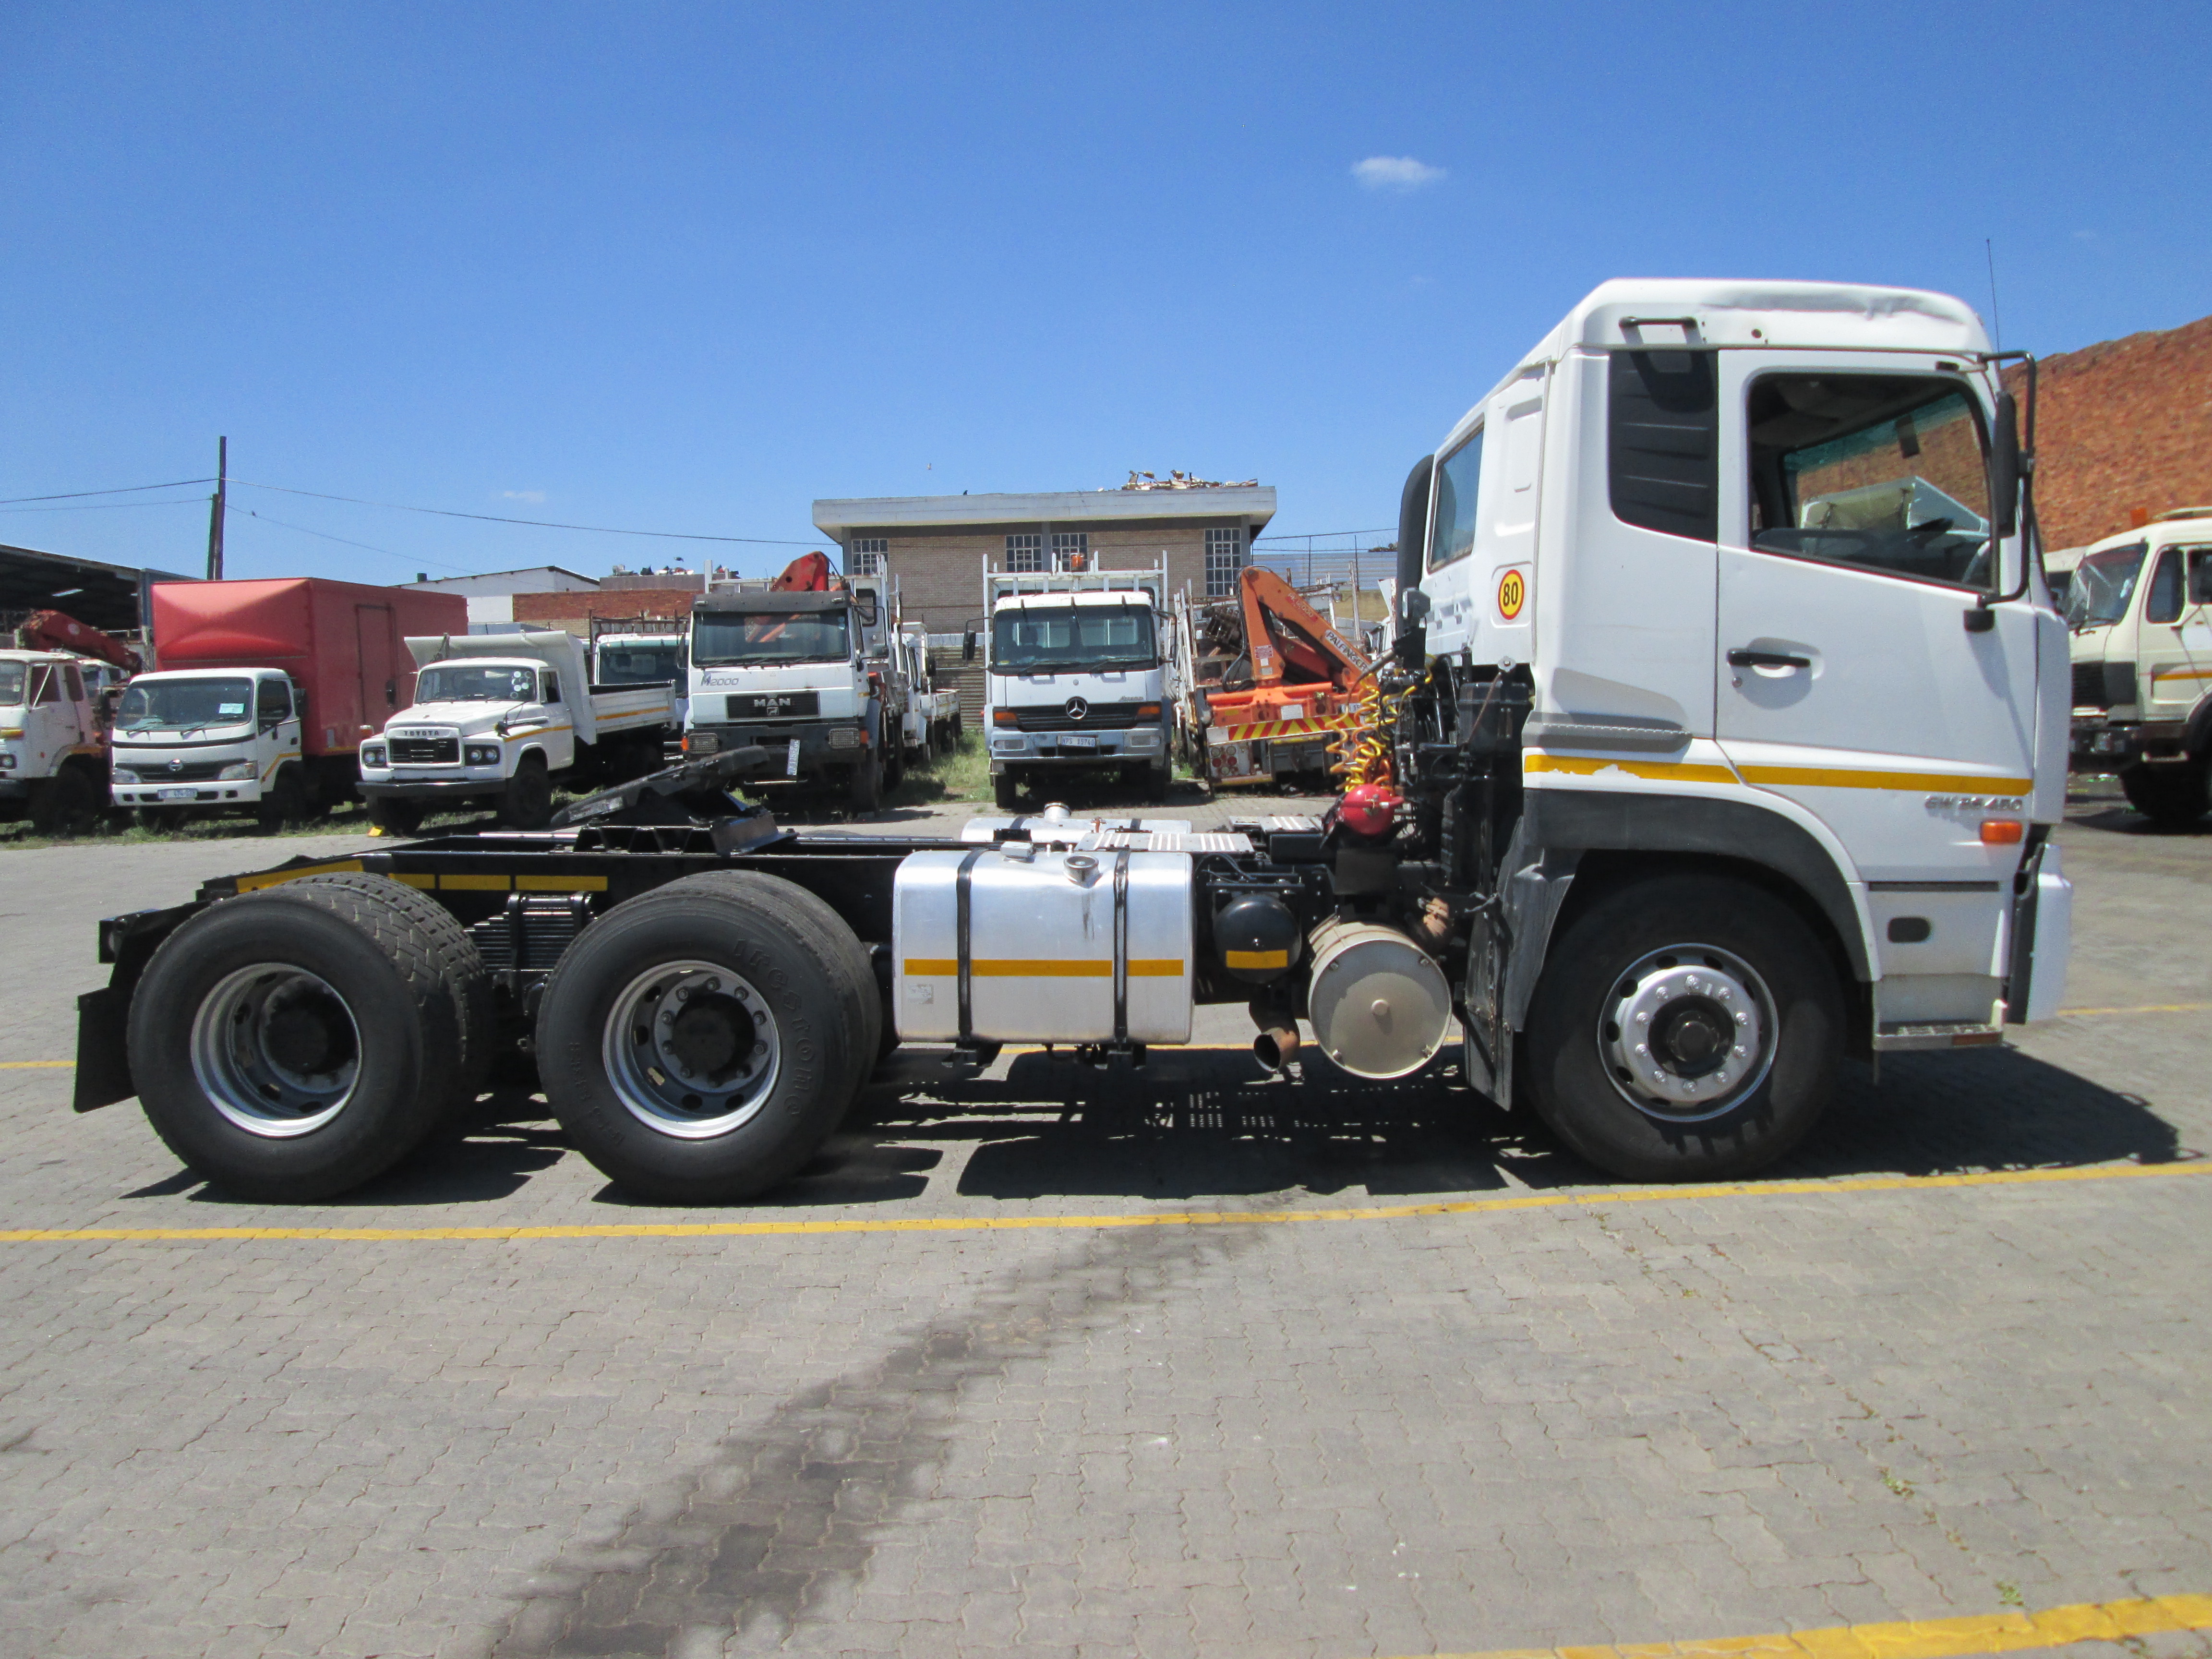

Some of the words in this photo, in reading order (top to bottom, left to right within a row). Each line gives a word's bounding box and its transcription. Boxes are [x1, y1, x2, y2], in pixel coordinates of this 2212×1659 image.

[1503, 581, 1518, 607] 80
[1327, 632, 1367, 671] PALFINGER
[754, 698, 791, 707] MAN
